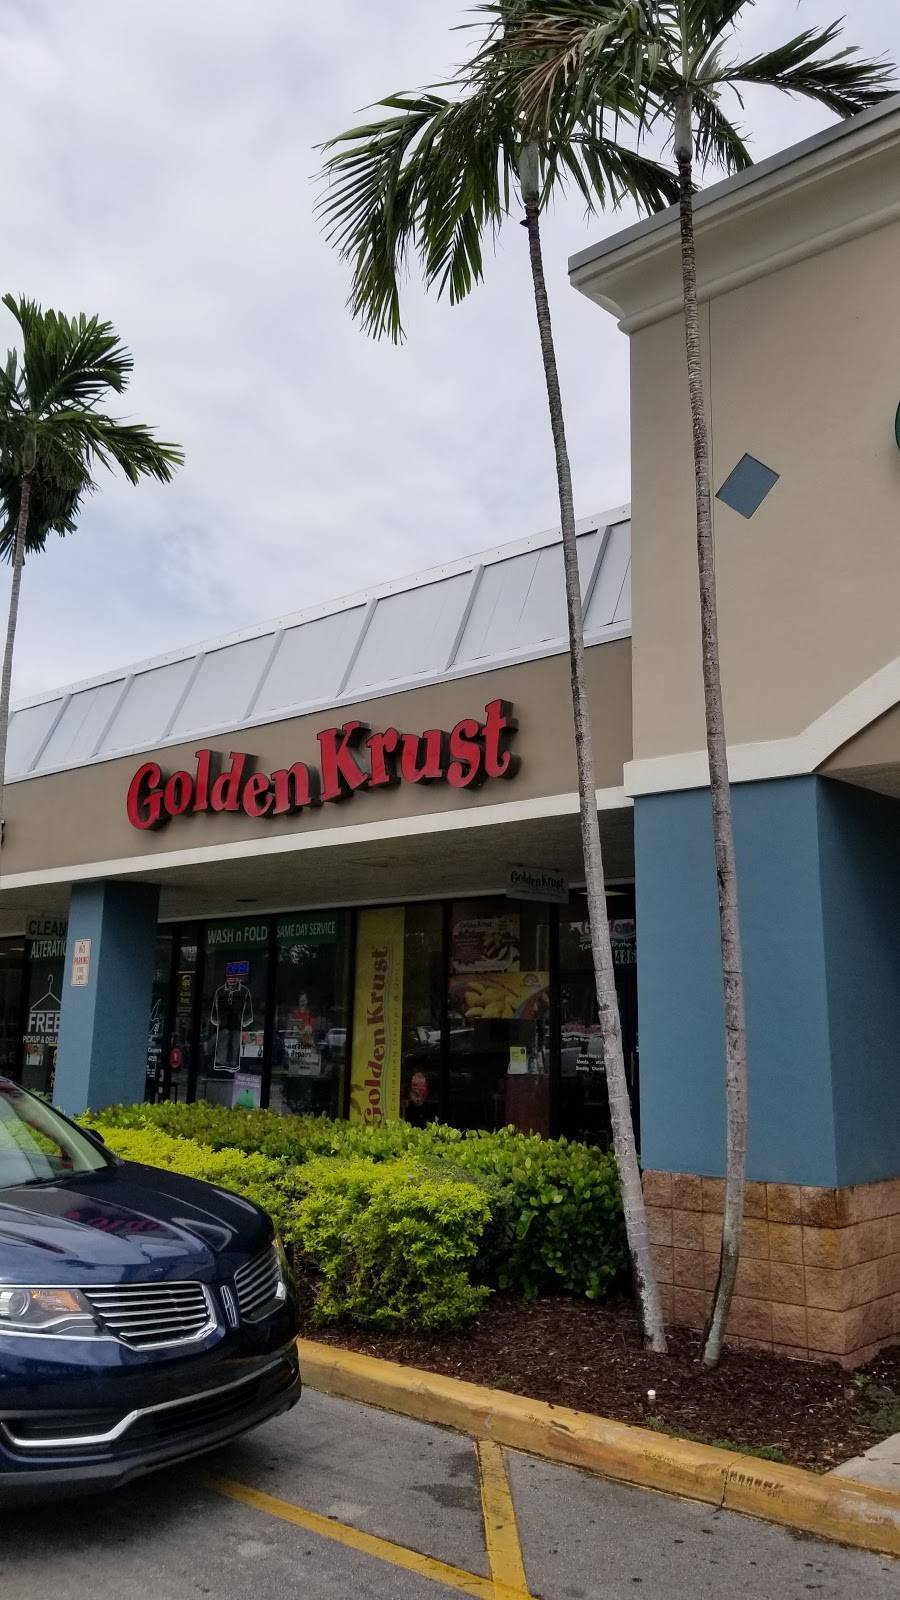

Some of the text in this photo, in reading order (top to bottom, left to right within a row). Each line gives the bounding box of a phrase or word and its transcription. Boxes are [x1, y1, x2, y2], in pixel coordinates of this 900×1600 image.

[207, 928, 234, 945] WASH
[243, 925, 268, 942] FOLD
[276, 920, 337, 939] SAME DAY SERVICE
[27, 1013, 61, 1033] FREE
